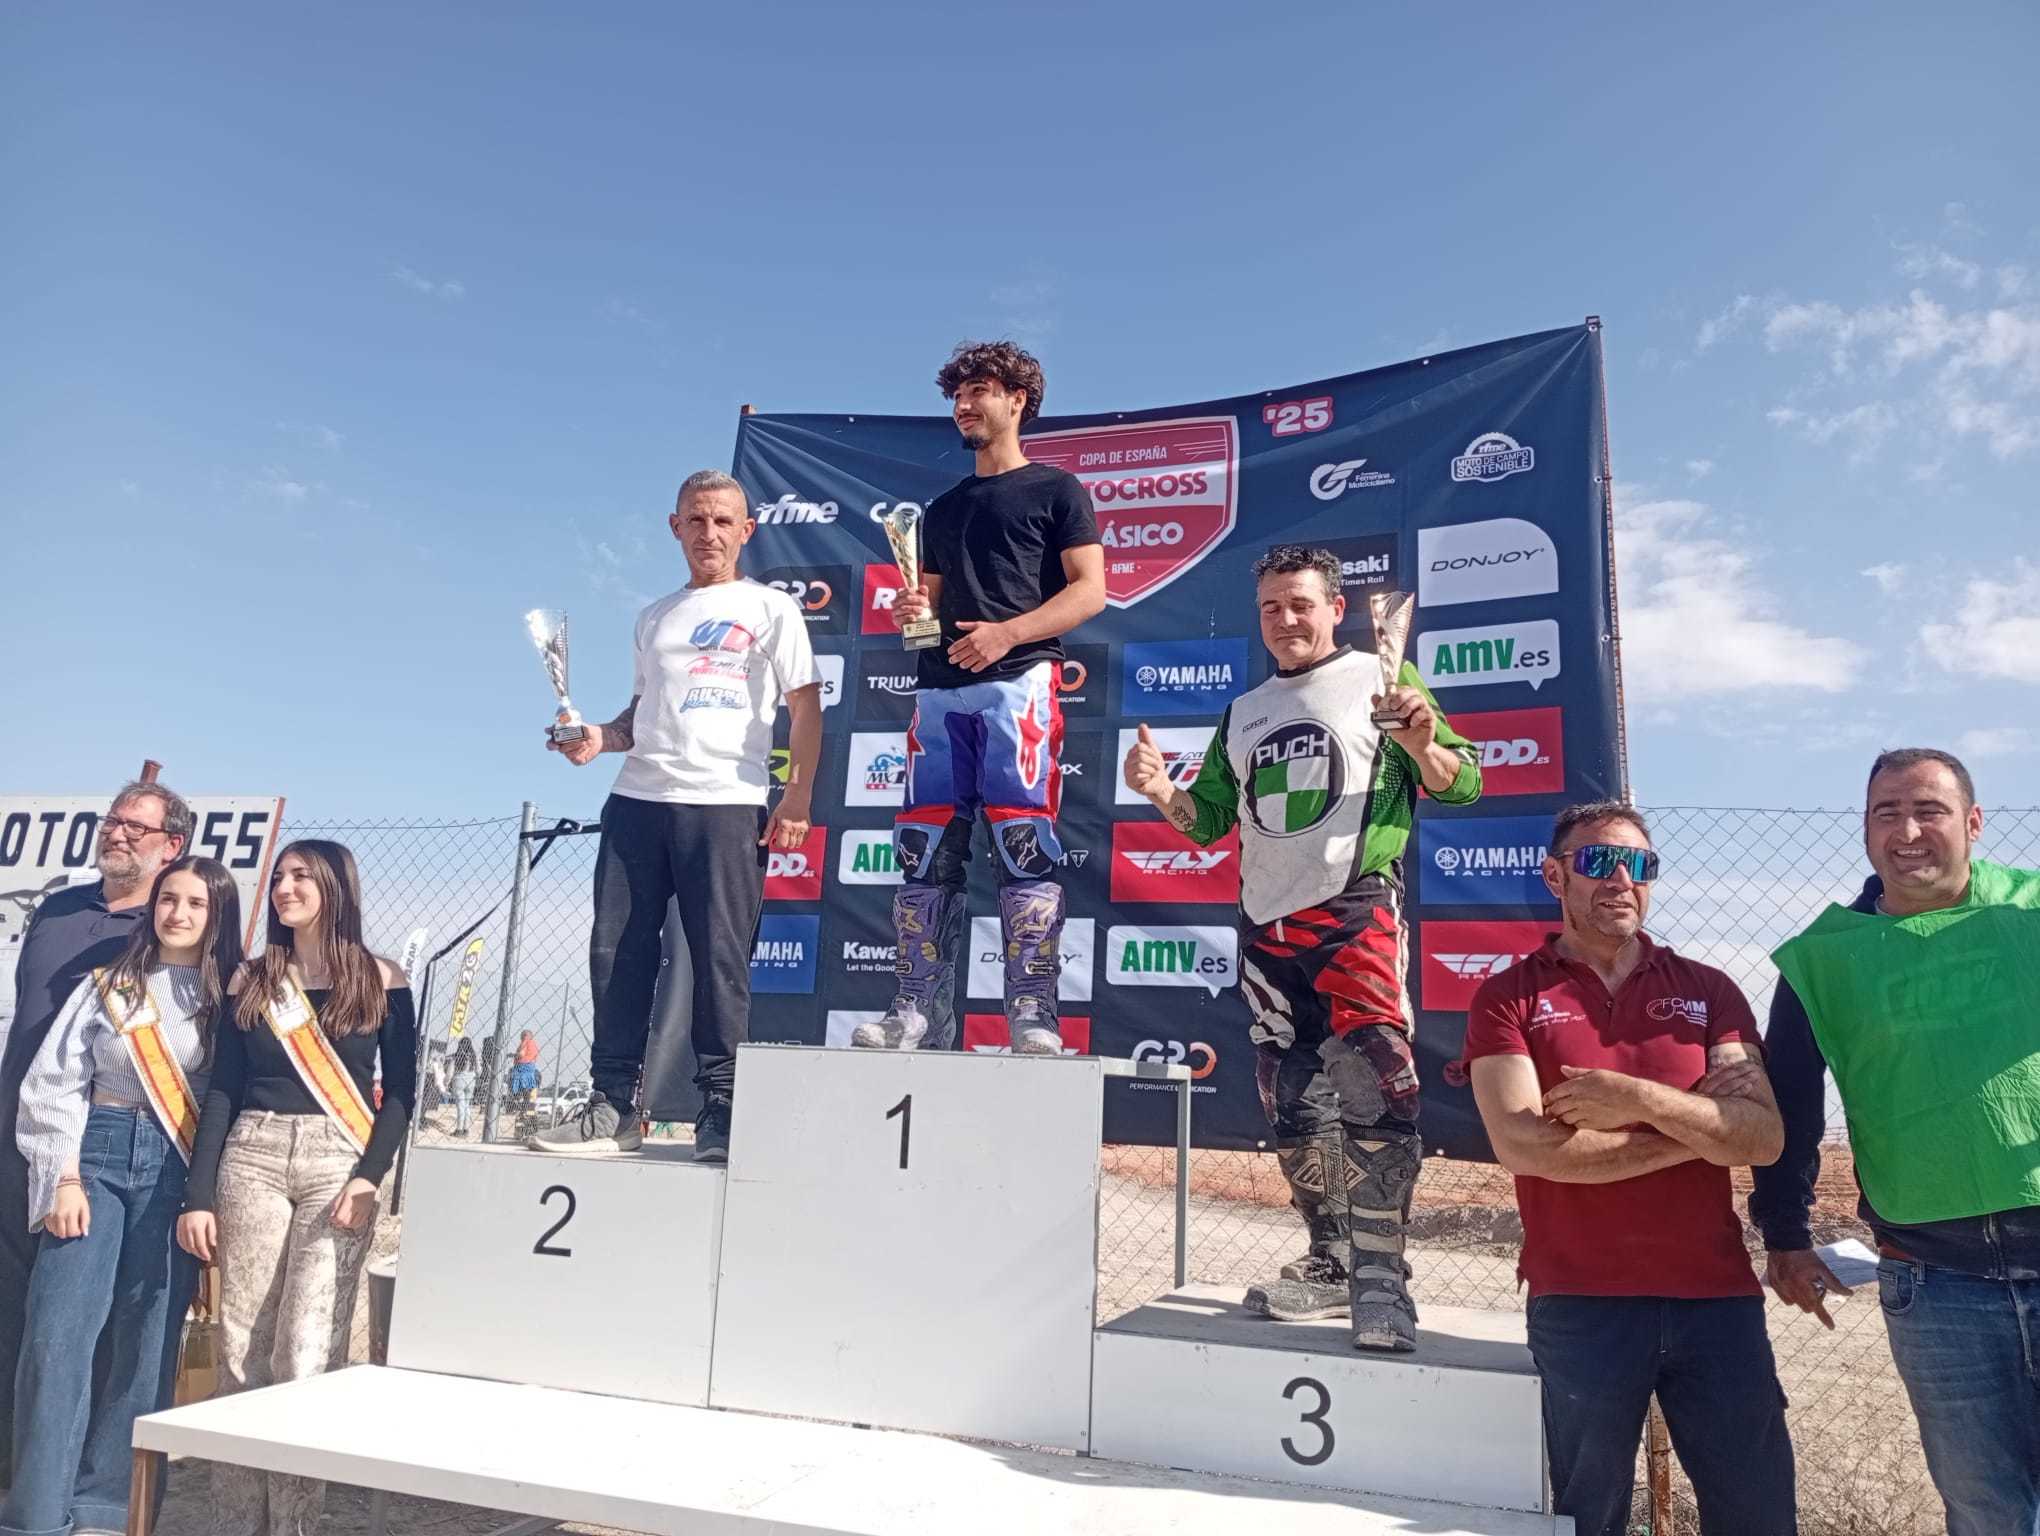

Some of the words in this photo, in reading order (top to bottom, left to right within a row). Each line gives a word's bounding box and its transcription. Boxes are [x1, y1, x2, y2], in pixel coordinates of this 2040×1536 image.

[1265, 399, 1330, 434] '25
[1080, 452, 1106, 466] COPA
[1109, 451, 1122, 464] DE
[1125, 445, 1168, 463] ESPAÑA
[1457, 458, 1482, 467] MOTO
[1484, 457, 1496, 465] DE
[1497, 450, 1529, 463] CAMPO
[1457, 457, 1529, 478] SOSTENIBLE
[1159, 664, 1233, 684] YAMAHA
[1143, 684, 1227, 692] RACING
[1256, 732, 1331, 768] PUCH
[1460, 846, 1549, 869] YAMAHA
[885, 1093, 914, 1170] 1
[532, 1185, 578, 1258] 2
[1280, 1376, 1336, 1467] 3
